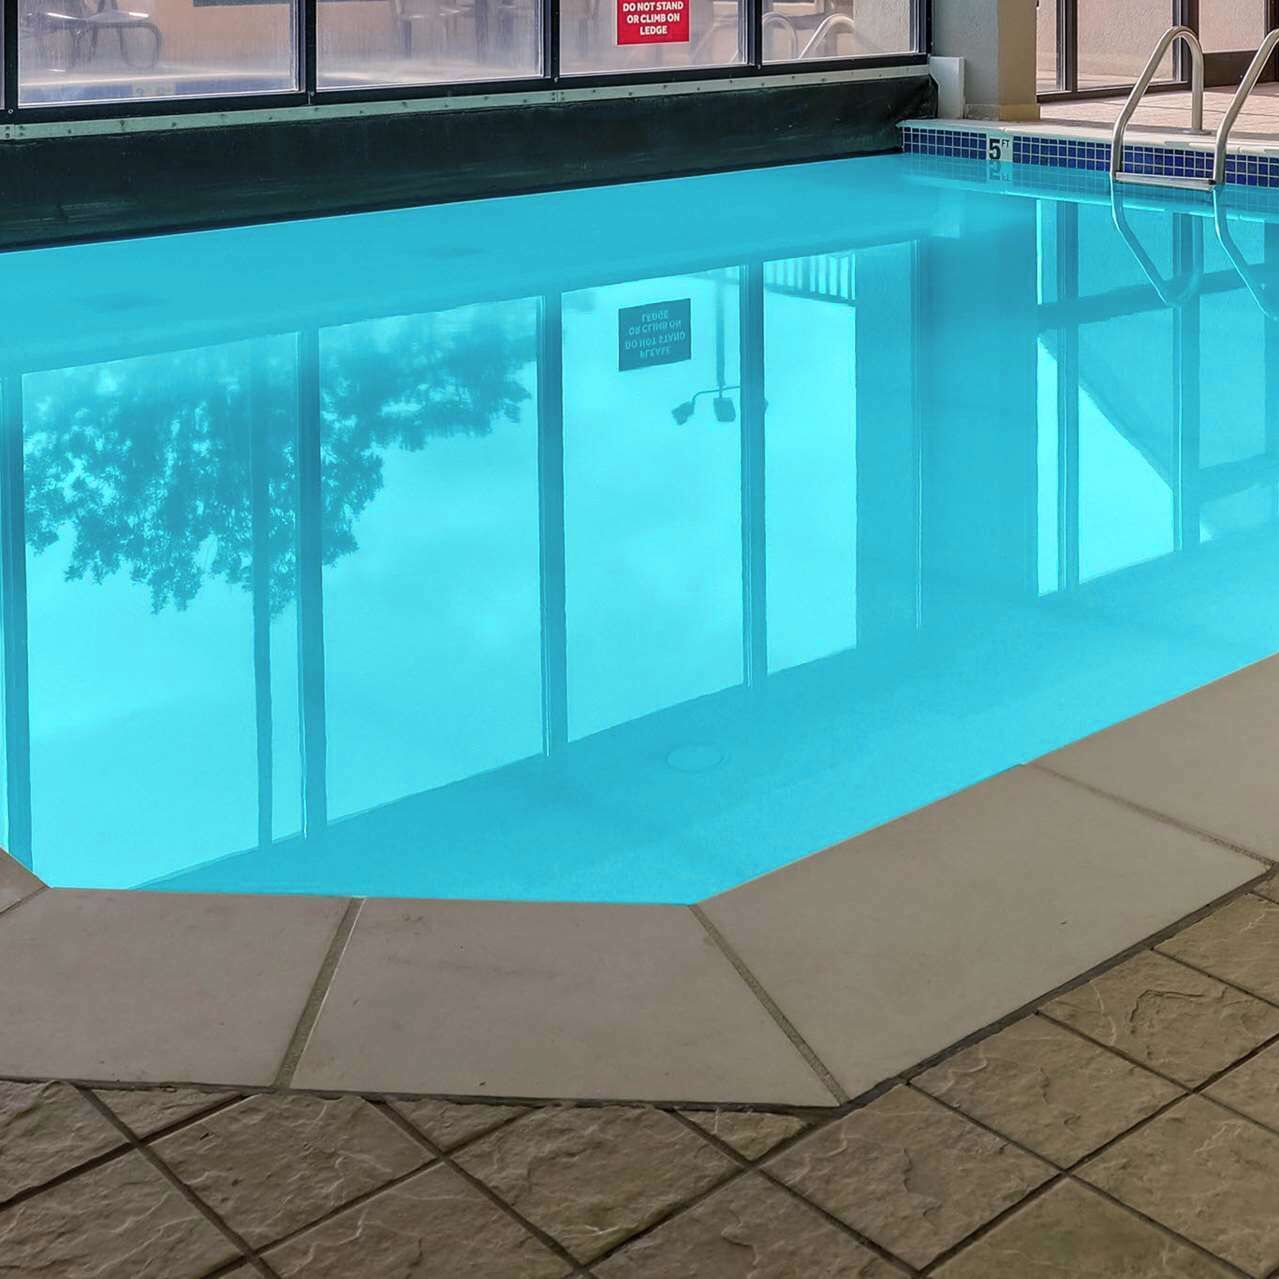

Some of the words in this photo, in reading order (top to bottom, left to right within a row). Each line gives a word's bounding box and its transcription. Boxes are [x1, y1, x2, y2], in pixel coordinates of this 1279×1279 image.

[623, 3, 636, 12] DO
[637, 2, 656, 11] NOT
[656, 1, 684, 11] STAND
[627, 14, 639, 24] OR
[640, 13, 666, 23] CLIMB
[667, 13, 680, 22] ON
[640, 25, 668, 35] LEDGE
[989, 139, 1001, 160] 5
